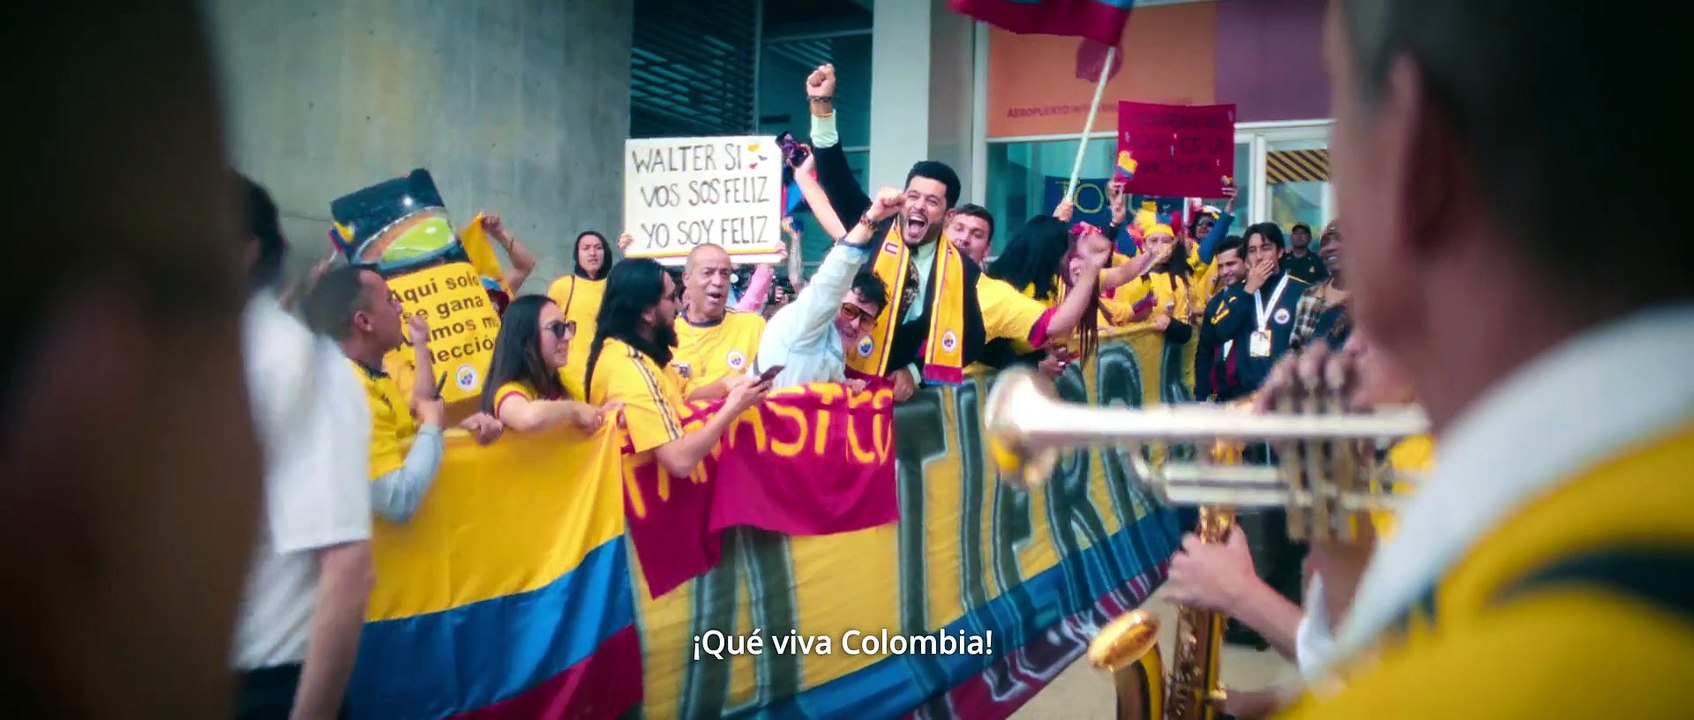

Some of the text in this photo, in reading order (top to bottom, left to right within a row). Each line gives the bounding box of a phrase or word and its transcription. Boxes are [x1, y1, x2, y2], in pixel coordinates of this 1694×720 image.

[632, 143, 742, 174] WALTER SI
[640, 176, 770, 208] VOS SOS FELIZ
[640, 215, 769, 249] YO SOY FELIZ
[436, 295, 484, 320] gana
